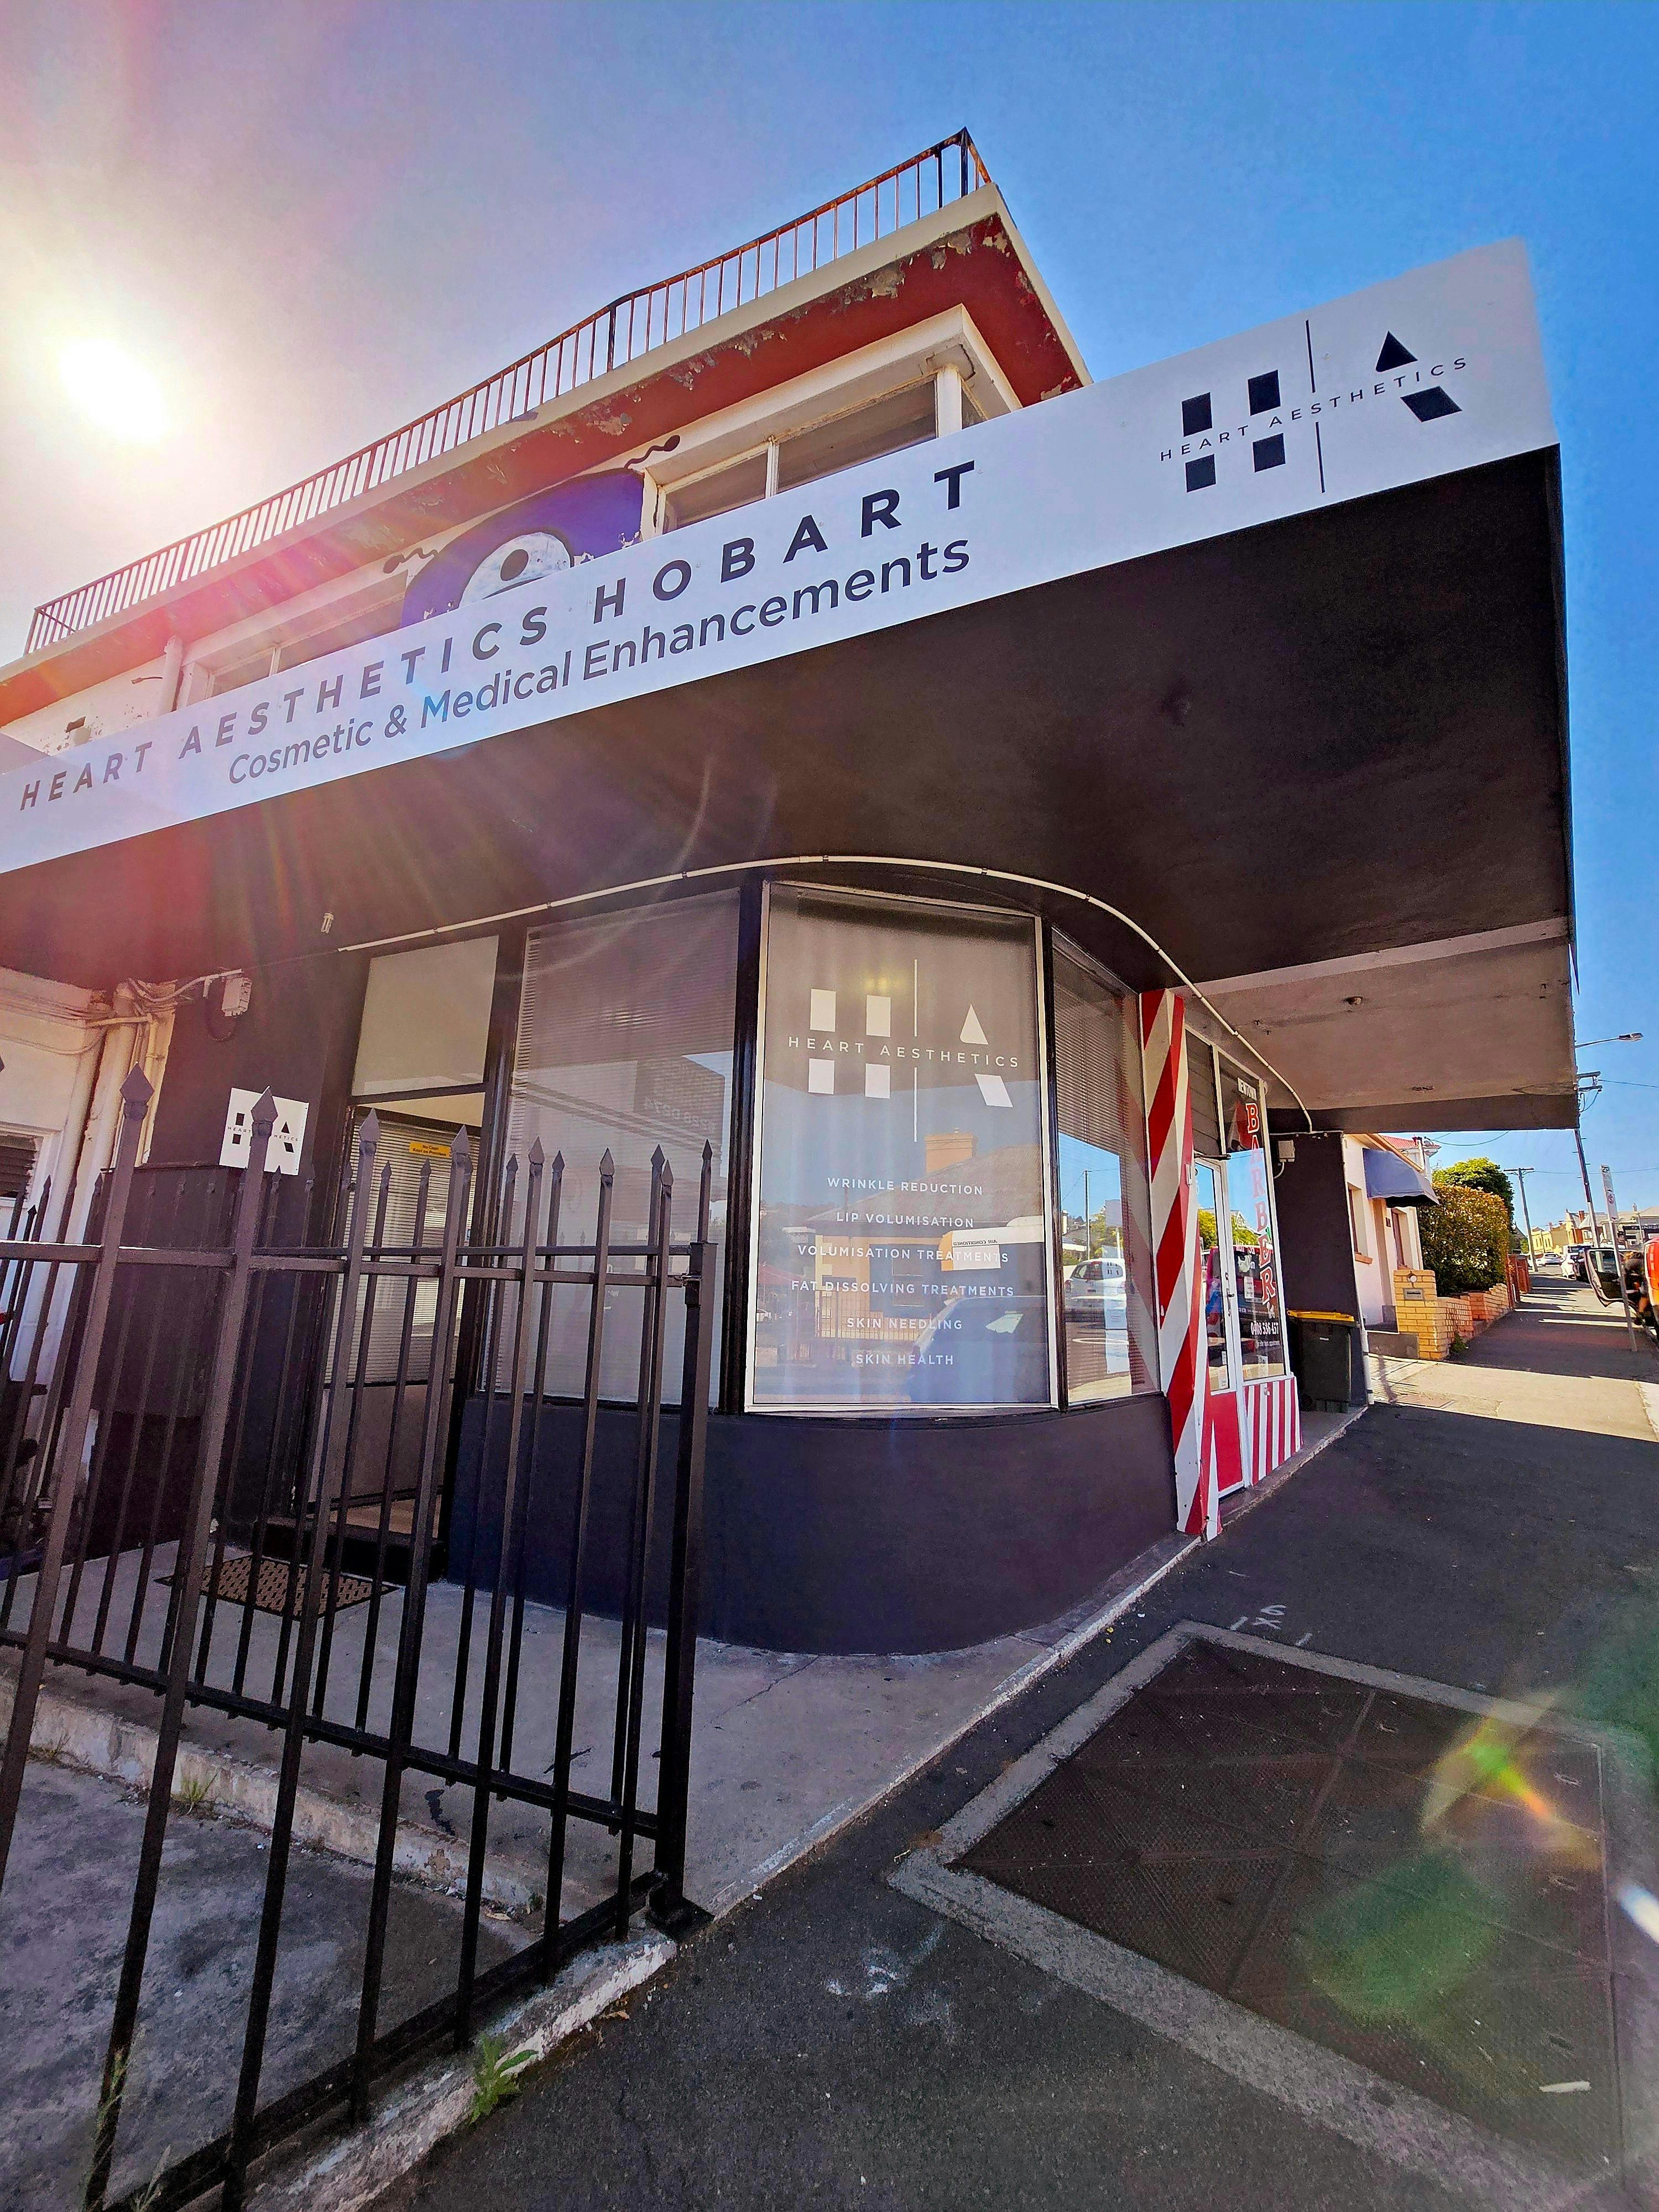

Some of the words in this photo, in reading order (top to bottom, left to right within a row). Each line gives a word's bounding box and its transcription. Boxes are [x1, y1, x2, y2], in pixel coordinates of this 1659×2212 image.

[1161, 425, 1249, 462] HEART
[1269, 357, 1467, 428] AESTHETICS
[20, 742, 153, 811] HEART
[179, 607, 547, 759] AESTHETICS
[593, 460, 975, 623] HOBART
[229, 717, 373, 785] Cosmetic
[384, 704, 407, 737] &
[420, 651, 570, 730] Medical
[583, 539, 970, 681] Enhancements
[788, 1036, 865, 1054] HEART
[880, 1045, 1019, 1067] AESTHETICS
[827, 1177, 894, 1191] WRINKLE
[901, 1181, 983, 1195] REDUCTION
[836, 1212, 859, 1223] LIP
[865, 1213, 974, 1228] VOLUMISATION
[797, 1244, 910, 1259] VOLUMISATION
[917, 1249, 1009, 1262] TREATMENTS
[791, 1281, 817, 1292] FAT
[825, 1281, 915, 1294] DISSOLVING
[922, 1284, 1014, 1297] TREATMENTS
[847, 1317, 882, 1329] SKIN
[889, 1318, 962, 1330] NEEDLING
[855, 1354, 890, 1365] SKIN
[898, 1354, 954, 1365] HEALTH
